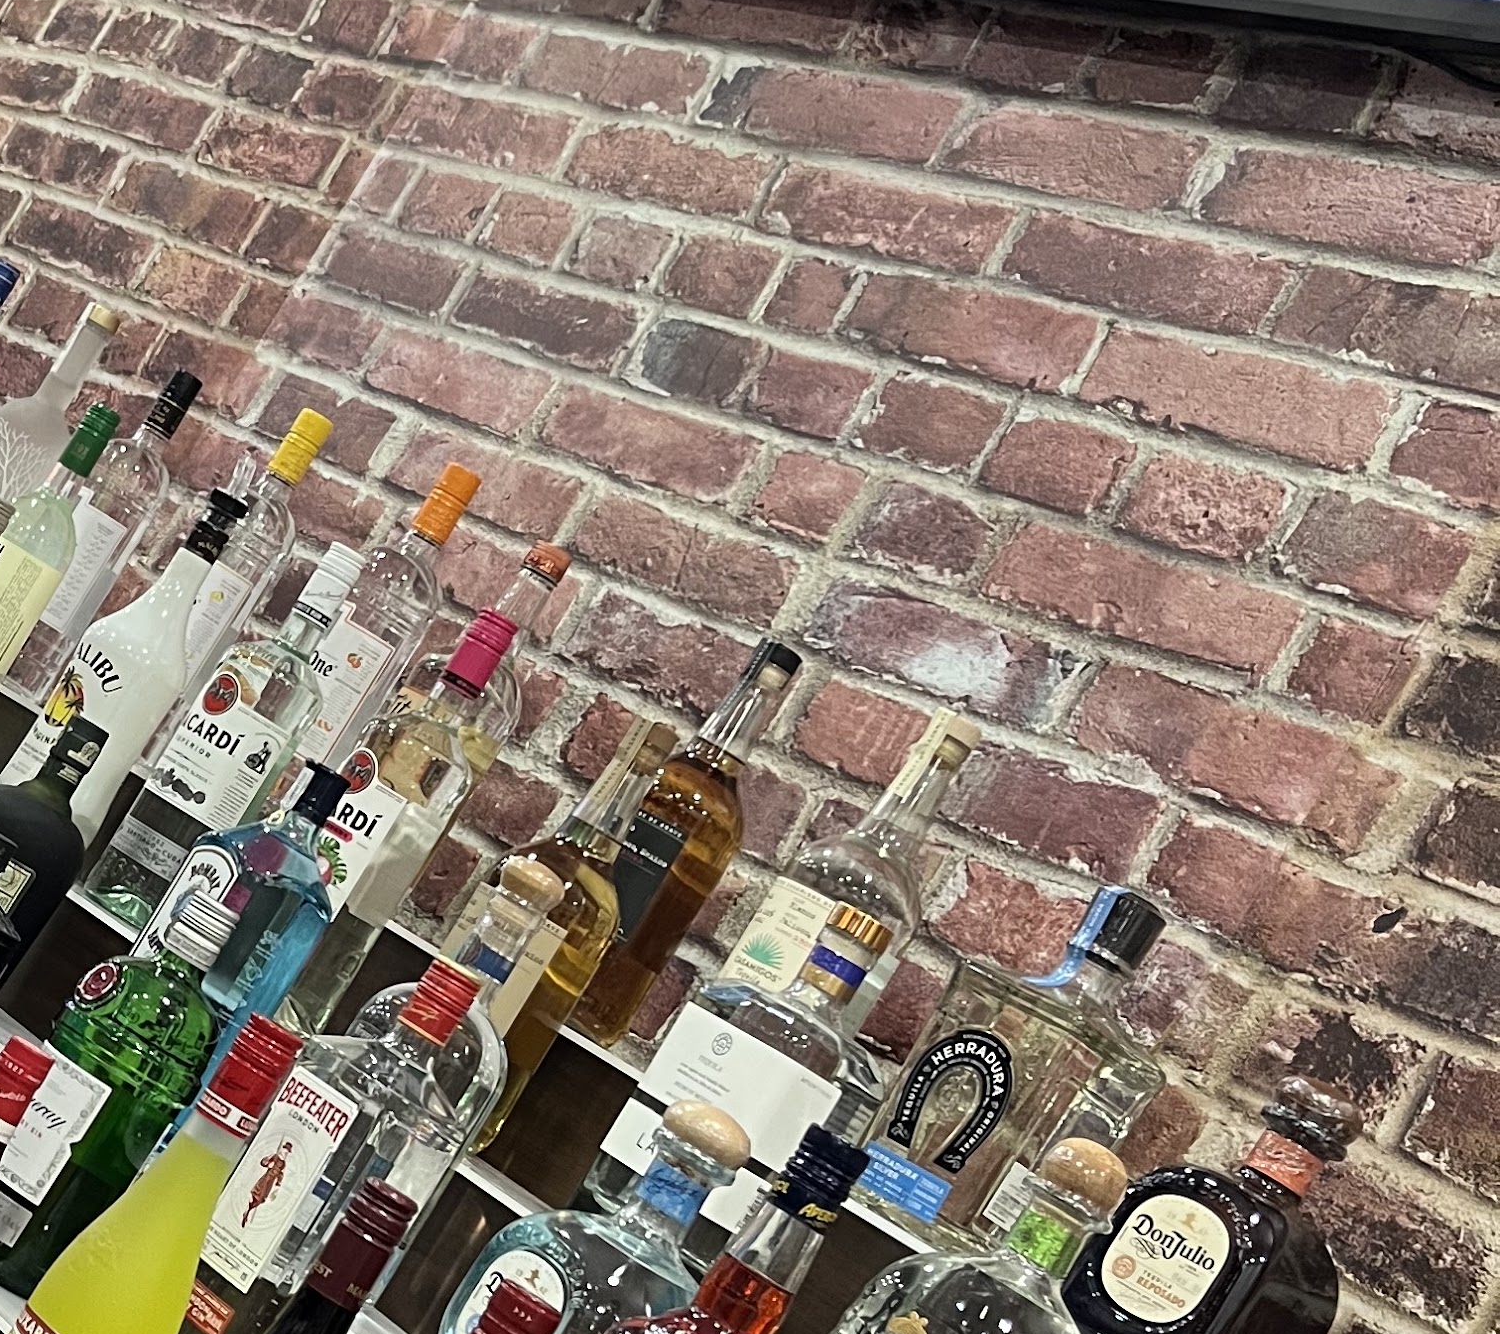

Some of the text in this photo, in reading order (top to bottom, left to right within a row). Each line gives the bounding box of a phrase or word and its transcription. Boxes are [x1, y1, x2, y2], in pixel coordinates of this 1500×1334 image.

[181, 713, 247, 757] CARDÍ
[930, 1040, 1005, 1098] HERRADURA
[277, 1076, 351, 1144] BEEFEATER
[900, 1074, 926, 1122] TEQUILA
[288, 1109, 320, 1135] LONDON
[958, 1109, 996, 1153] ORIGINAL
[1132, 1213, 1175, 1250] Don
[1136, 1275, 1186, 1309] REPOSADO
